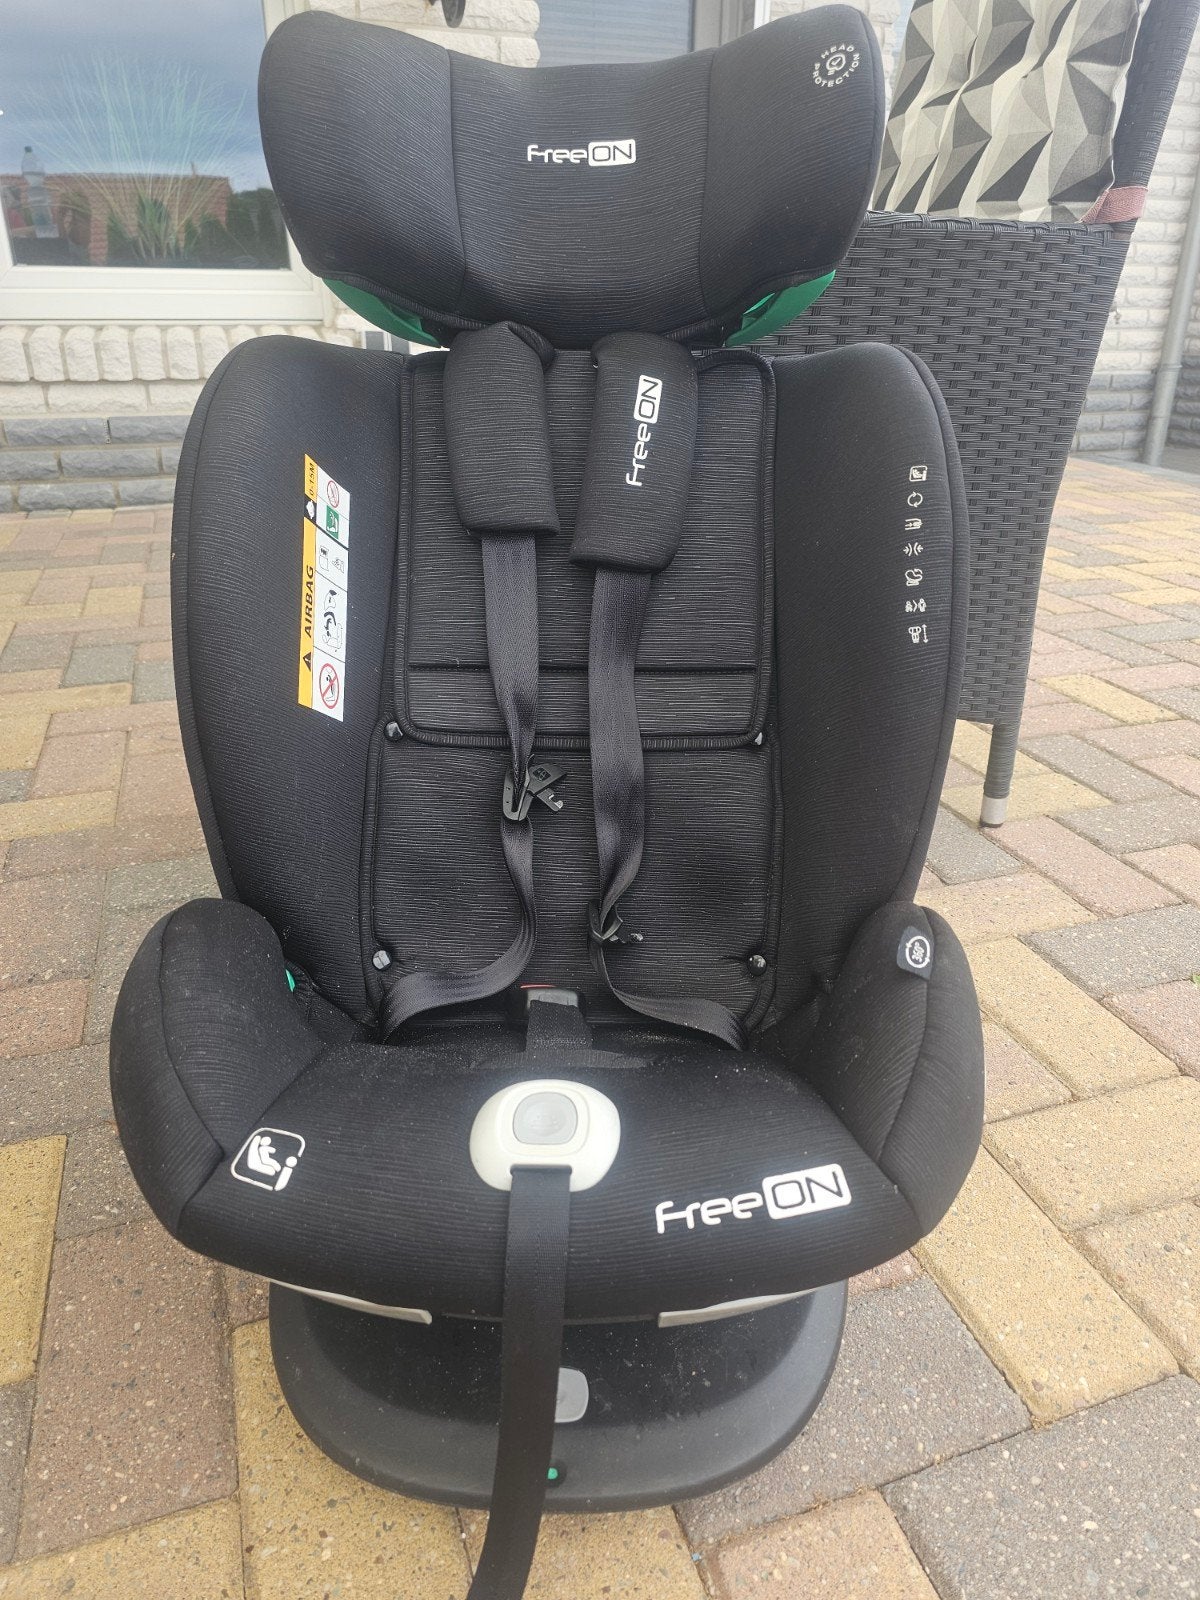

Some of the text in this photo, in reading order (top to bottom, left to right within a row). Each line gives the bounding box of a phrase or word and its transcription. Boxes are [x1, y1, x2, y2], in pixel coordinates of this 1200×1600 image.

[821, 43, 855, 59] HEAD
[813, 53, 860, 87] PROTECTION
[304, 564, 314, 639] AIRBAG
